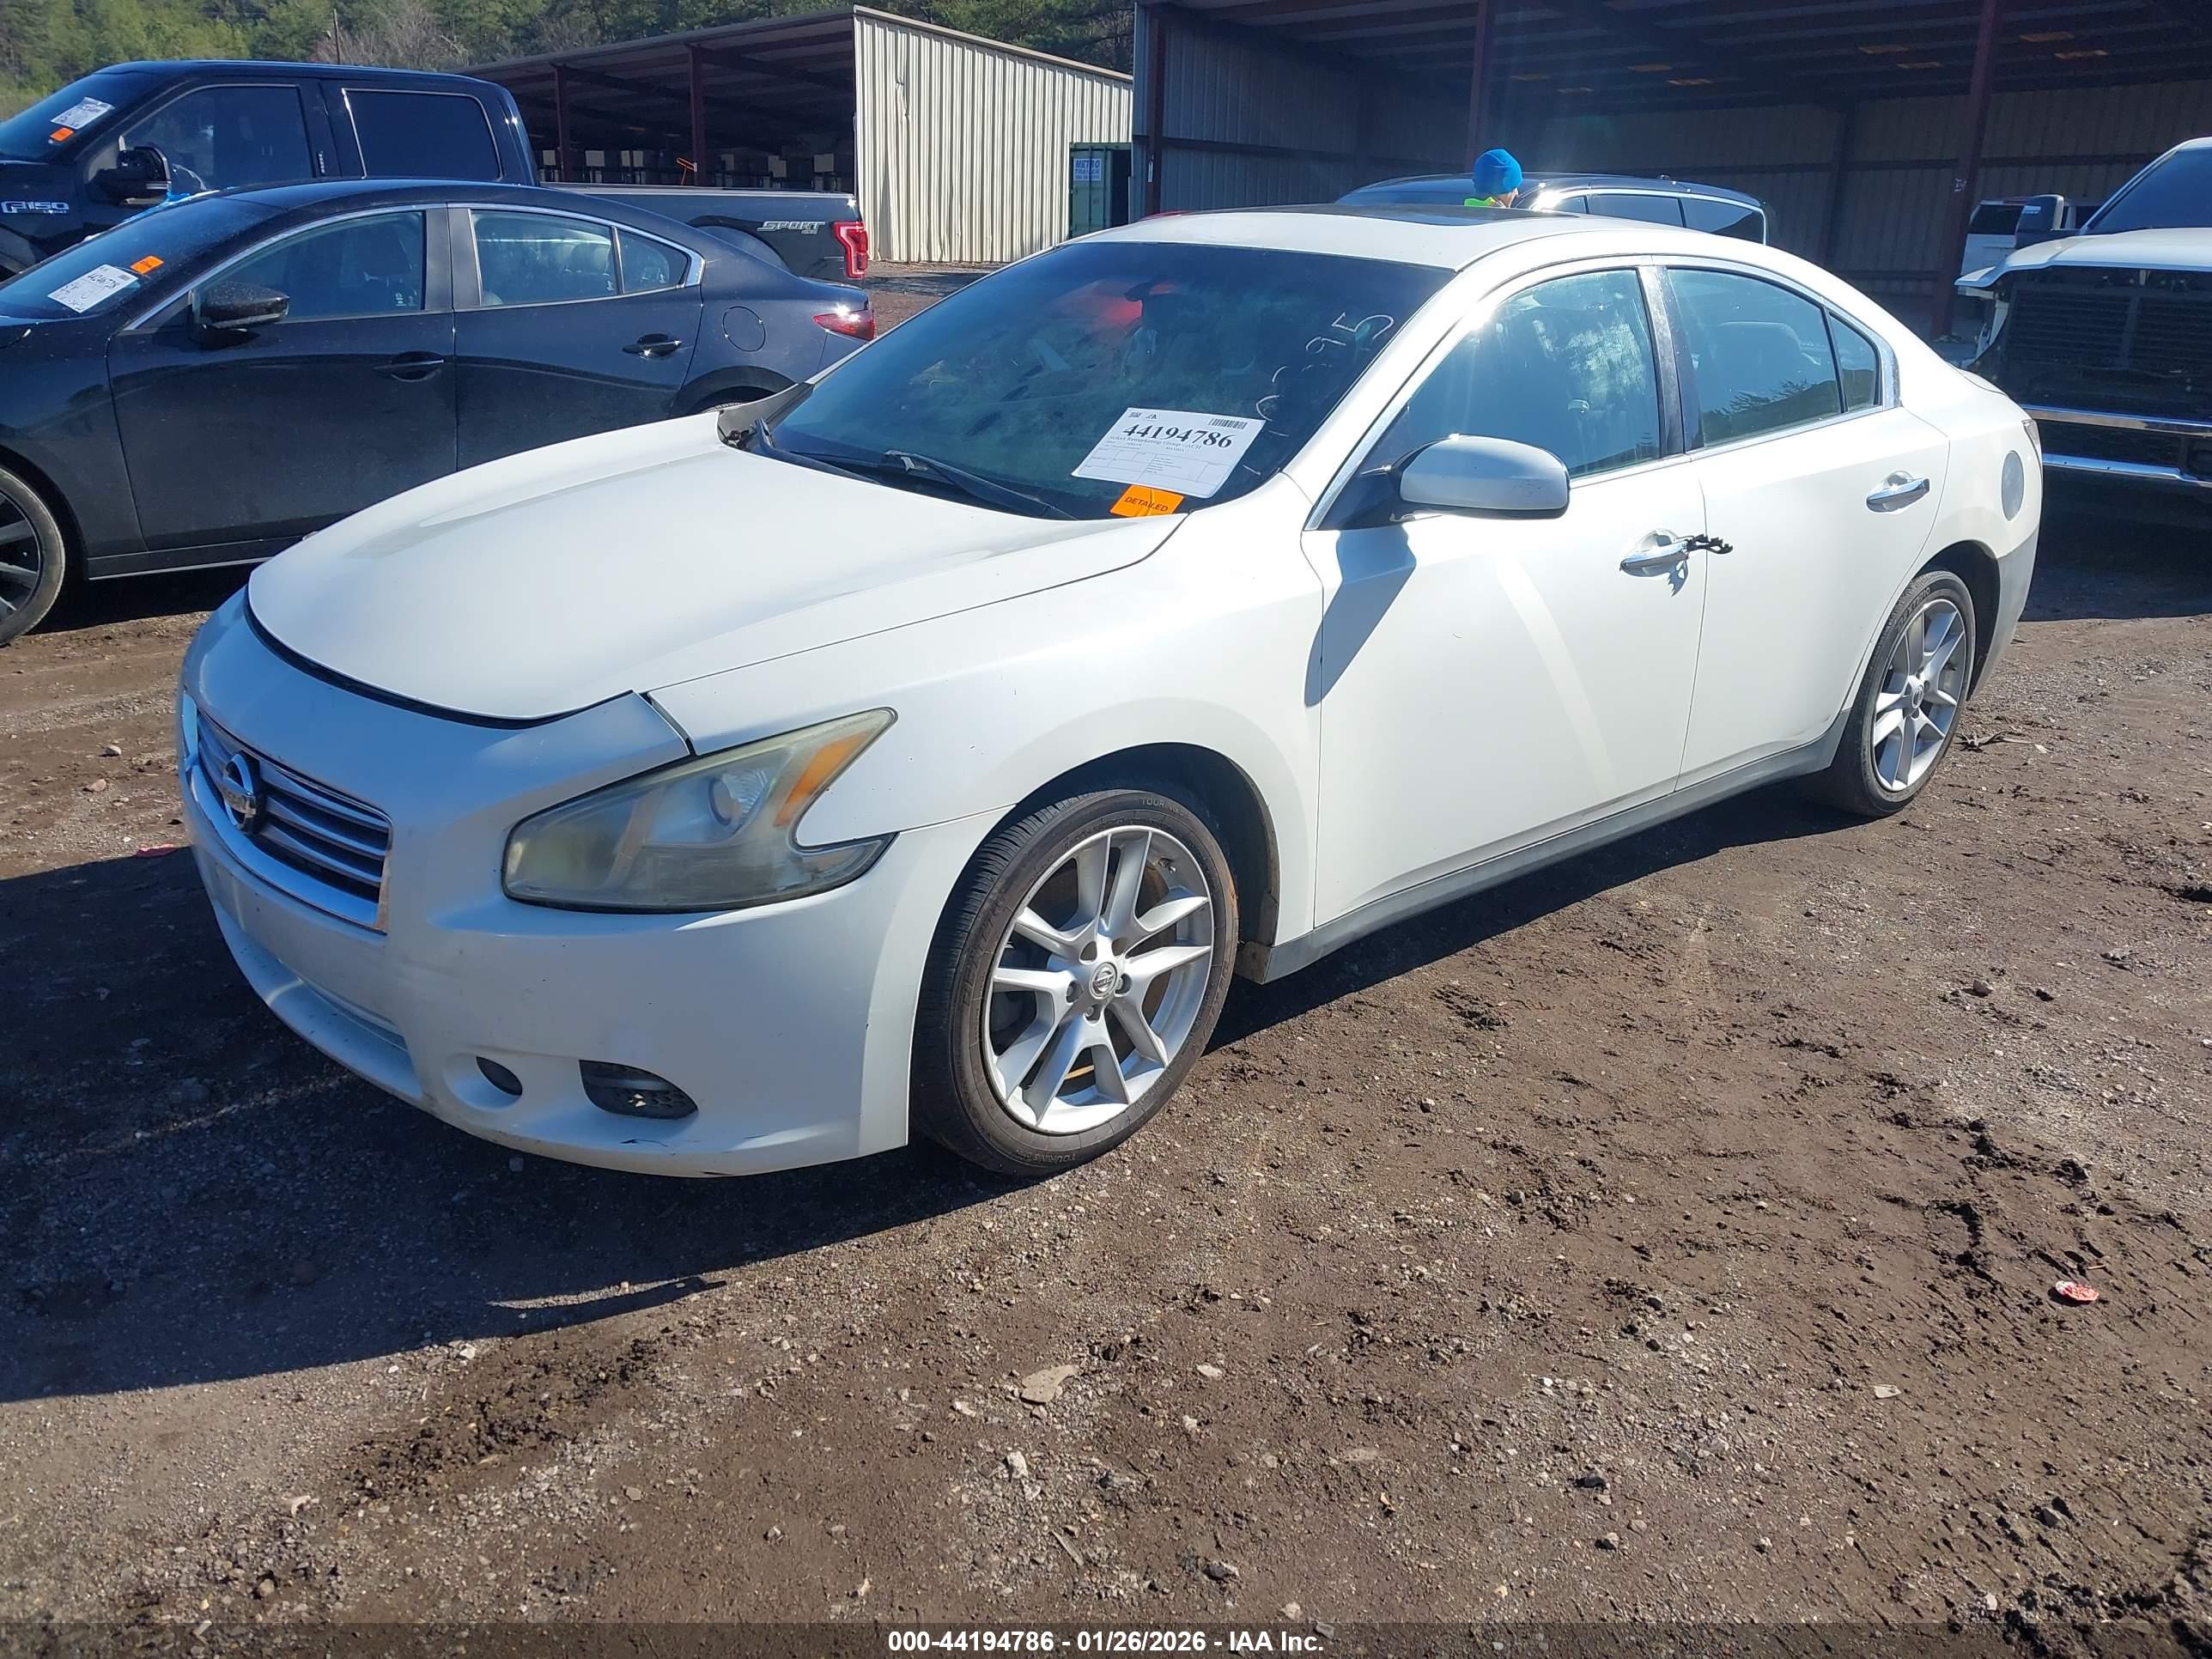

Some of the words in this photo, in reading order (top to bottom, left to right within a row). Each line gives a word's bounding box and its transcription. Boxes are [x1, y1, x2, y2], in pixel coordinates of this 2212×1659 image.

[757, 221, 826, 232] SPORT
[1122, 423, 1237, 448] 44194786
[1125, 495, 1169, 512] DETAILED
[1139, 796, 1179, 814] TOURING
